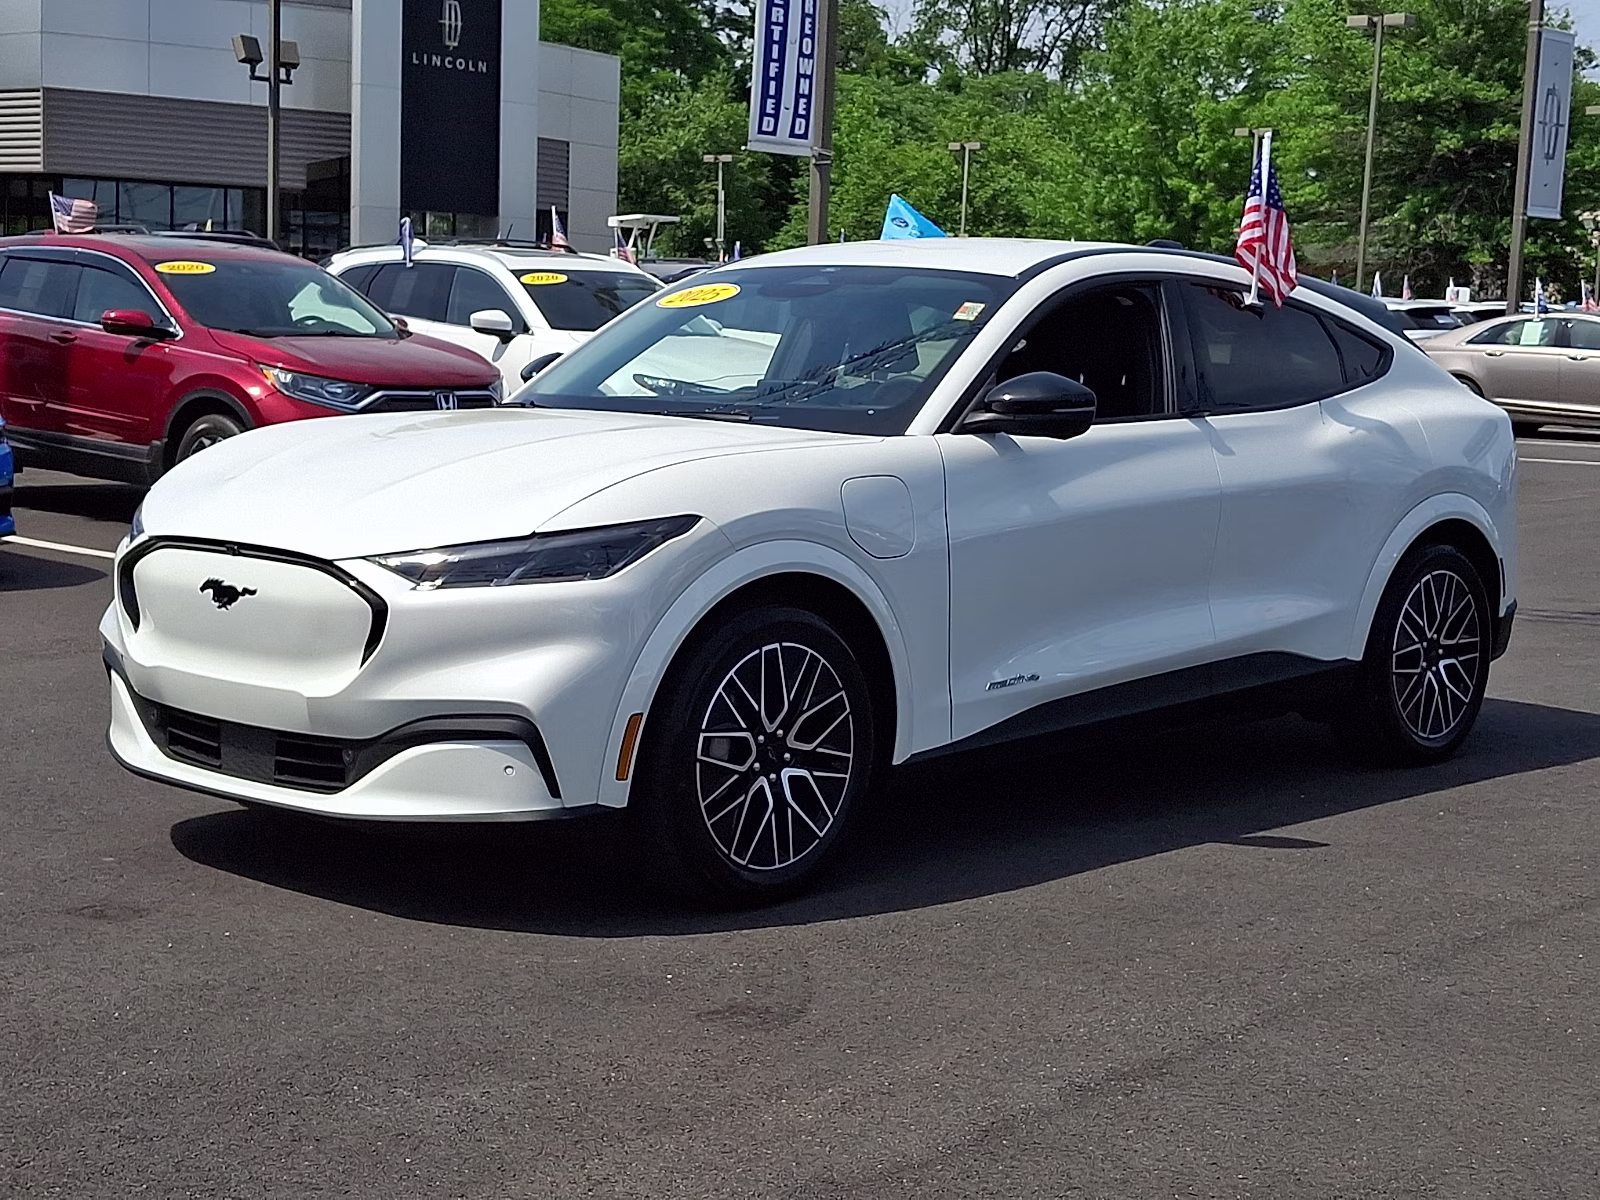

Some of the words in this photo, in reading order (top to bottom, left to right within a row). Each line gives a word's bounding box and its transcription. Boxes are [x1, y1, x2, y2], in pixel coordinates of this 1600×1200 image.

[412, 52, 487, 73] LINCOLN
[761, 0, 785, 132] RTIFIED
[529, 275, 559, 283] 2020
